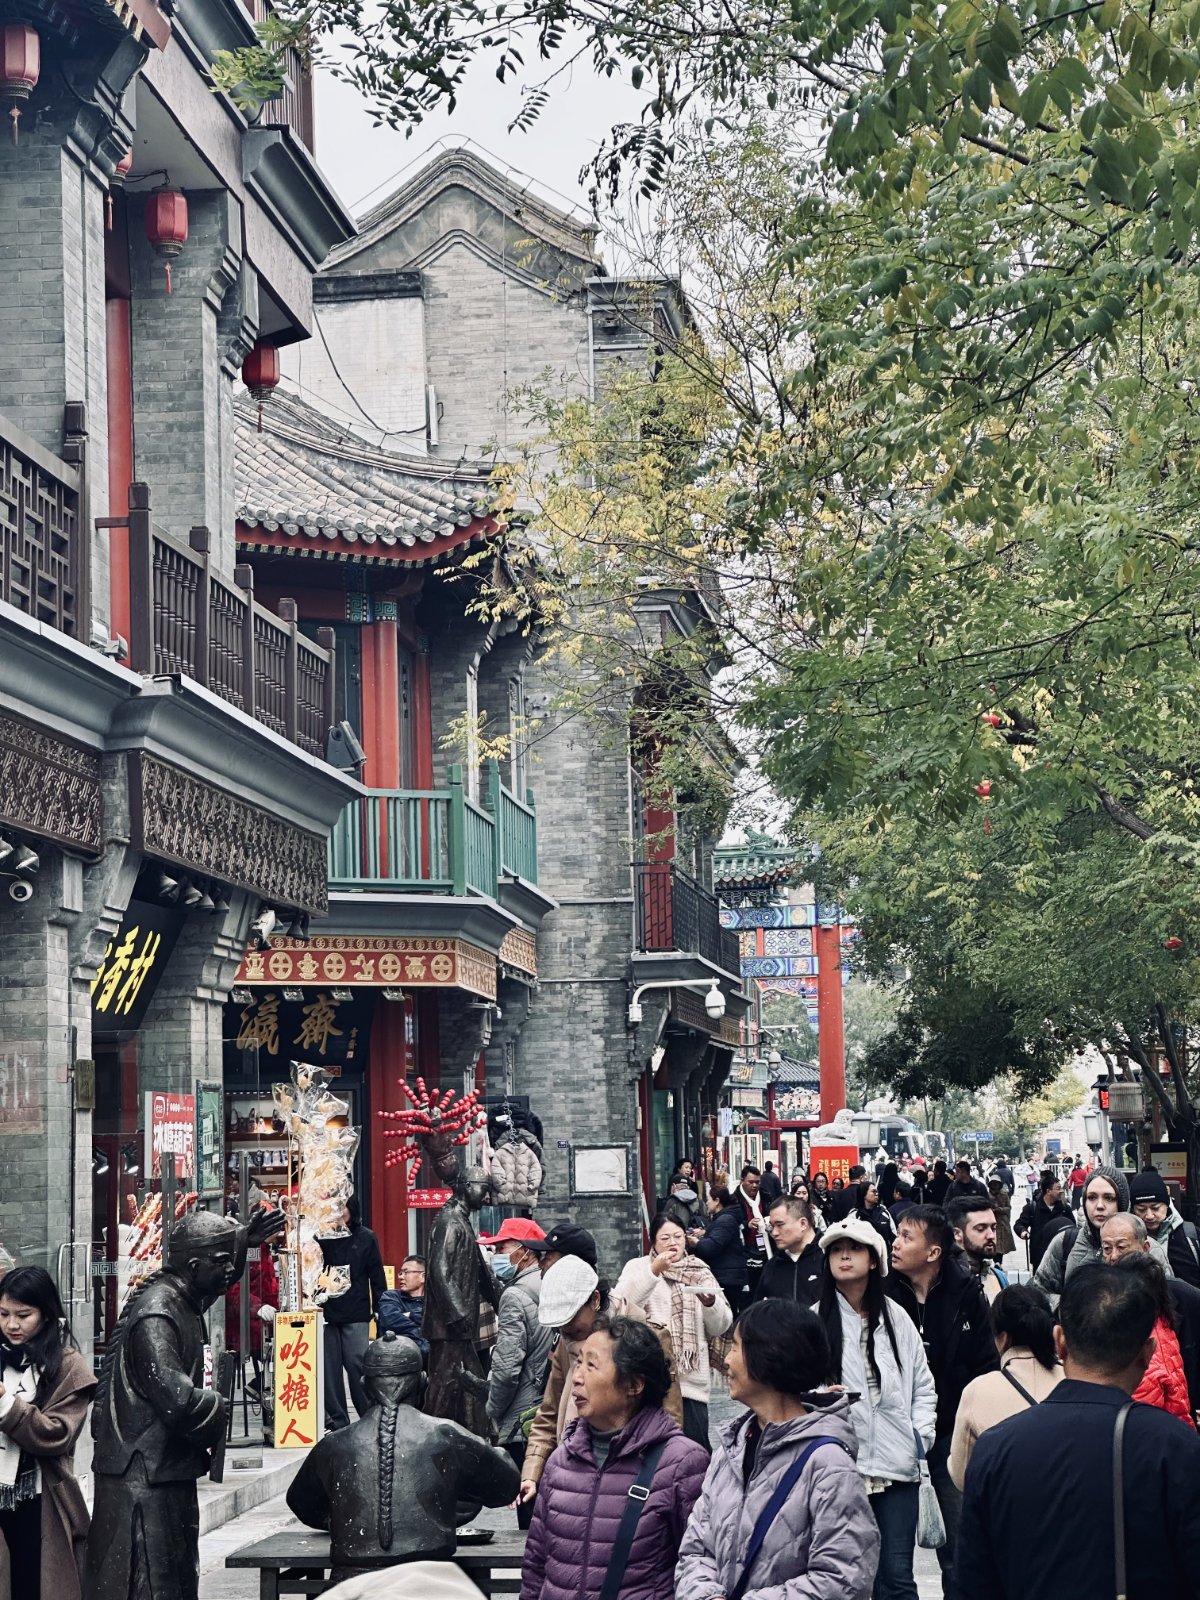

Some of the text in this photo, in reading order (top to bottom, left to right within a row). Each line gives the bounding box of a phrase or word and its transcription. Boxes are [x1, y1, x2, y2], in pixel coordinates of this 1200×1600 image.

[91, 926, 160, 1015] 香村
[153, 1121, 193, 1154] 冰糖葫芦
[279, 1329, 314, 1444] 吹糖人
